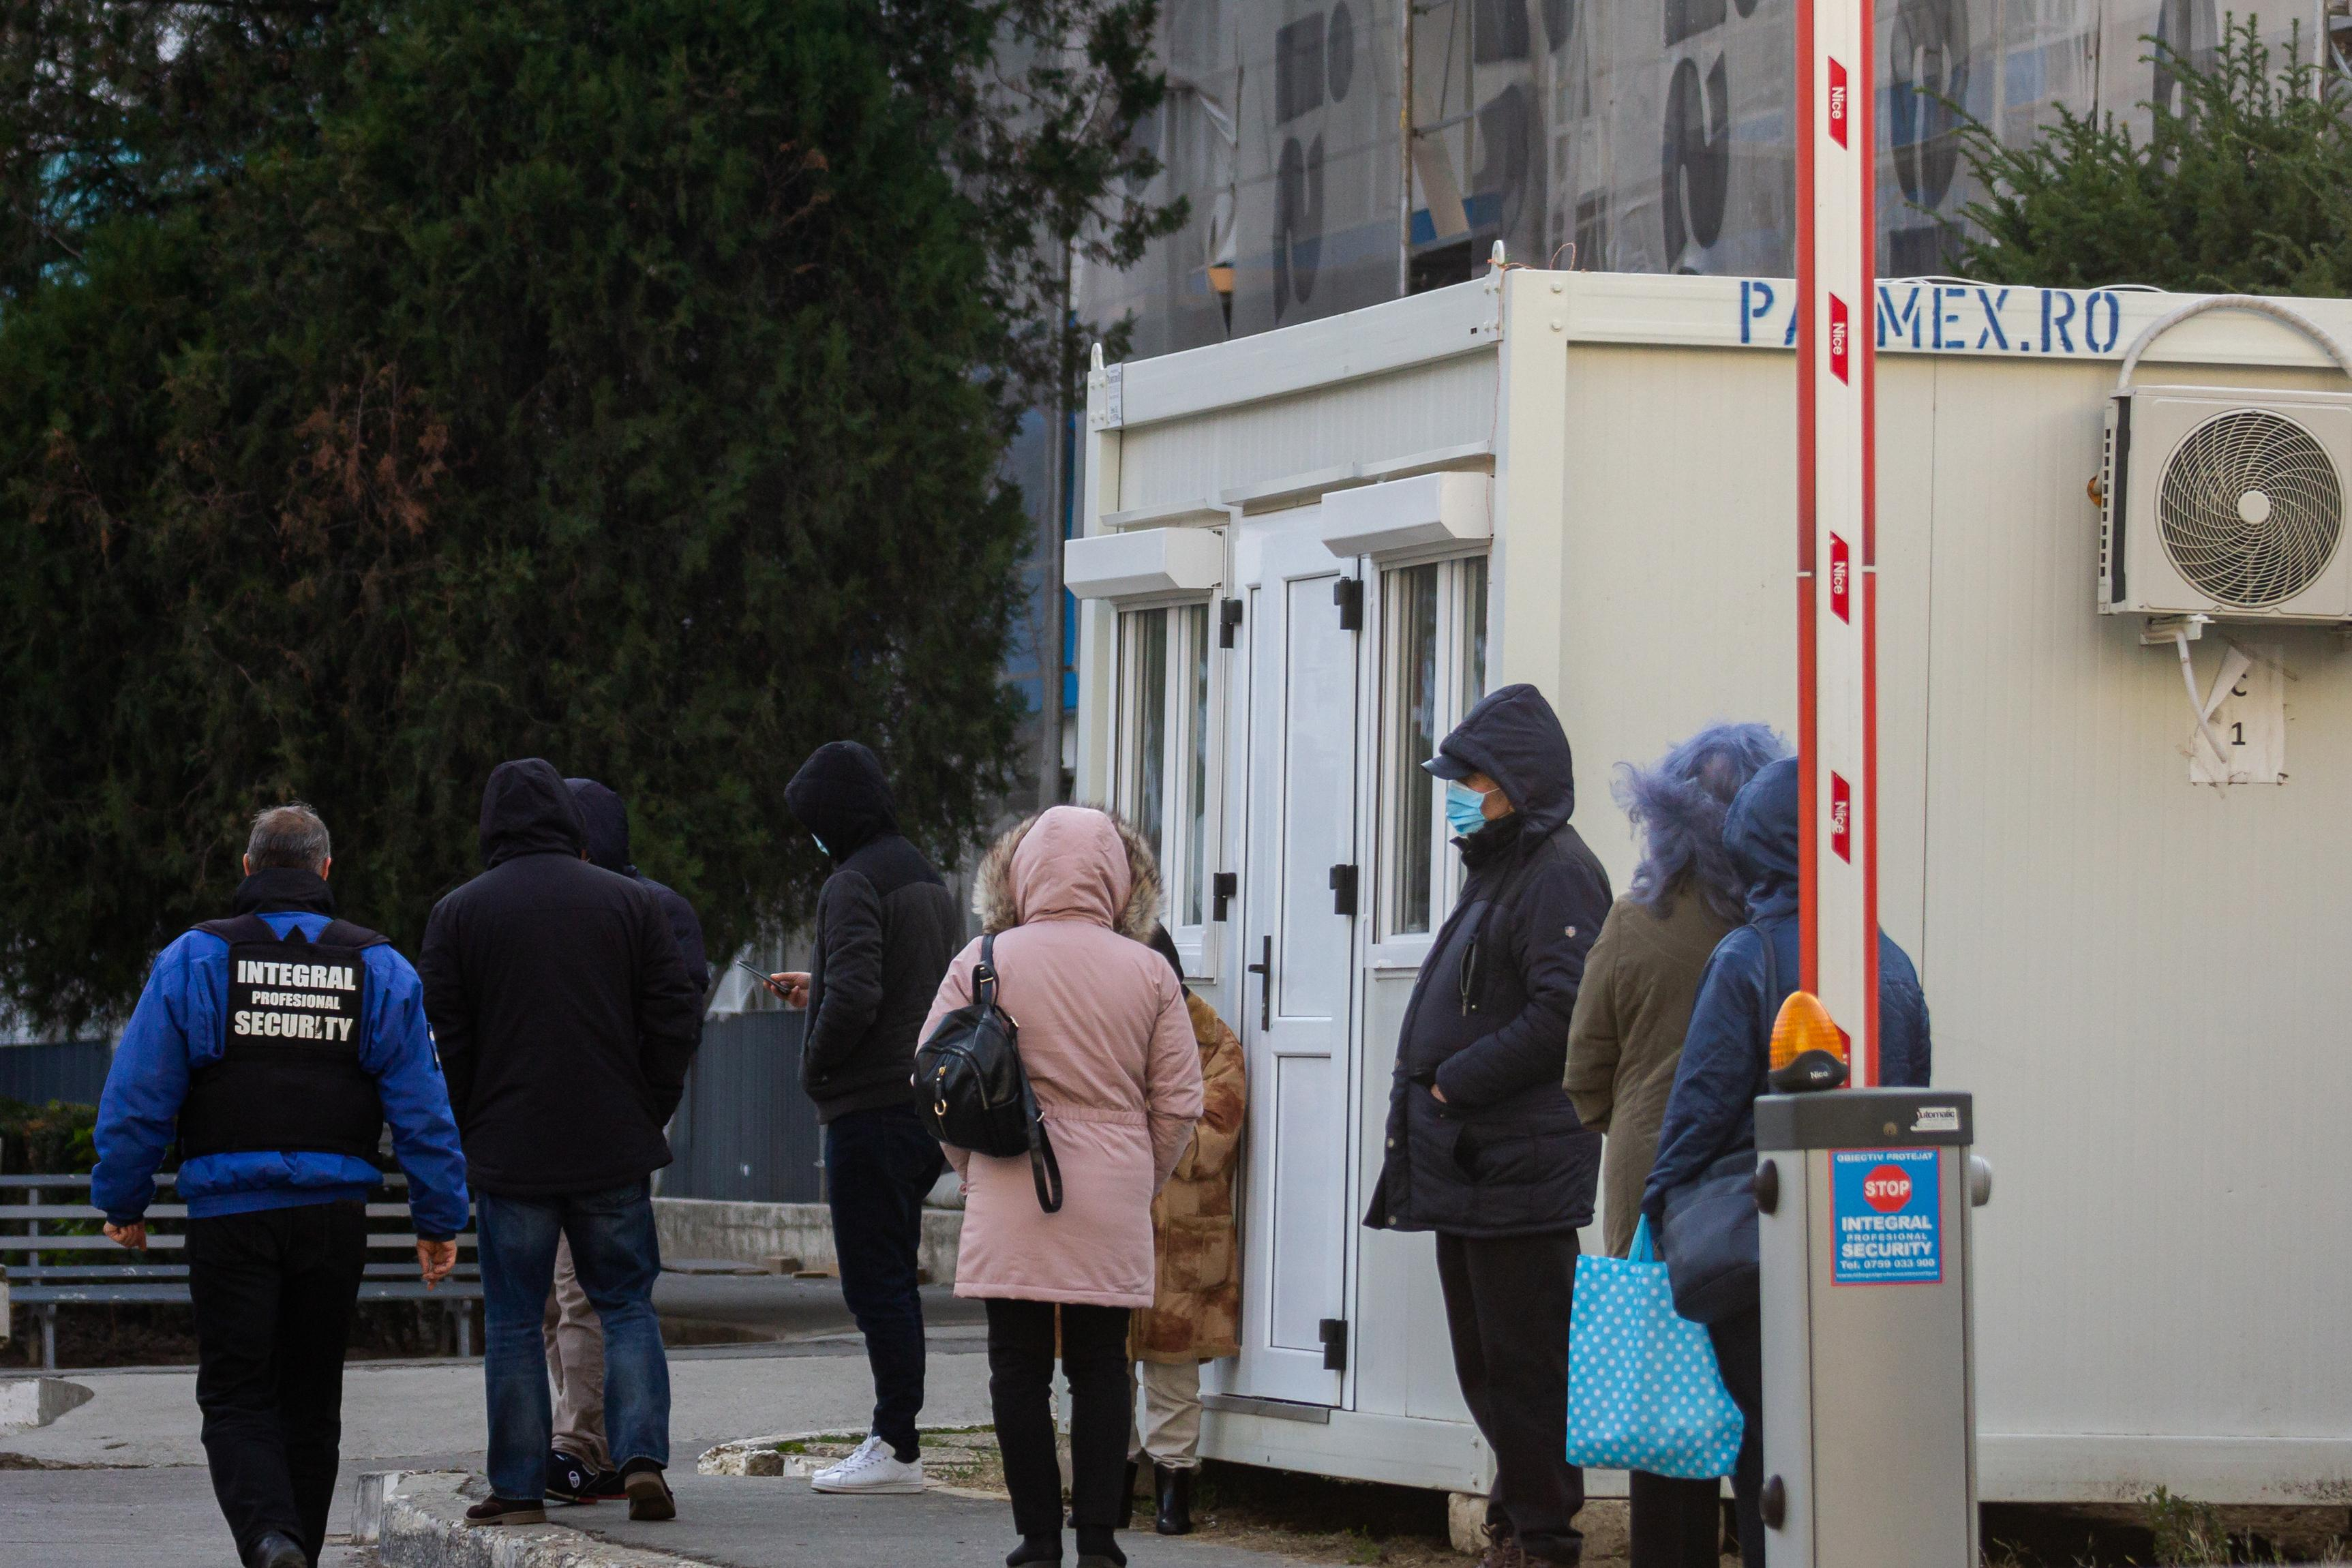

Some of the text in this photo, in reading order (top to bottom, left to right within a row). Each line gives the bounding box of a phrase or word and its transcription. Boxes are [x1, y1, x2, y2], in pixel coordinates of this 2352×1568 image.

[1831, 87, 1844, 119] Nice
[1740, 280, 2120, 354] PMEX.RO
[1832, 322, 1845, 355] Nice
[1833, 562, 1845, 594] Nice
[2231, 721, 2246, 746] 1
[1835, 801, 1847, 834] Nice
[237, 960, 356, 991] INTEGRAL
[252, 991, 341, 1010] PROFESIONAL
[234, 1010, 354, 1042] SECURITY
[1837, 1152, 1933, 1163] OBIECTIV PROTEJAT
[1865, 1180, 1910, 1197] STOP
[1841, 1215, 1933, 1232] INTEGRAL
[1841, 1241, 1932, 1258] SECURITY
[1846, 1233, 1928, 1242] PROFESIONAL
[1840, 1260, 1860, 1269] Tel.
